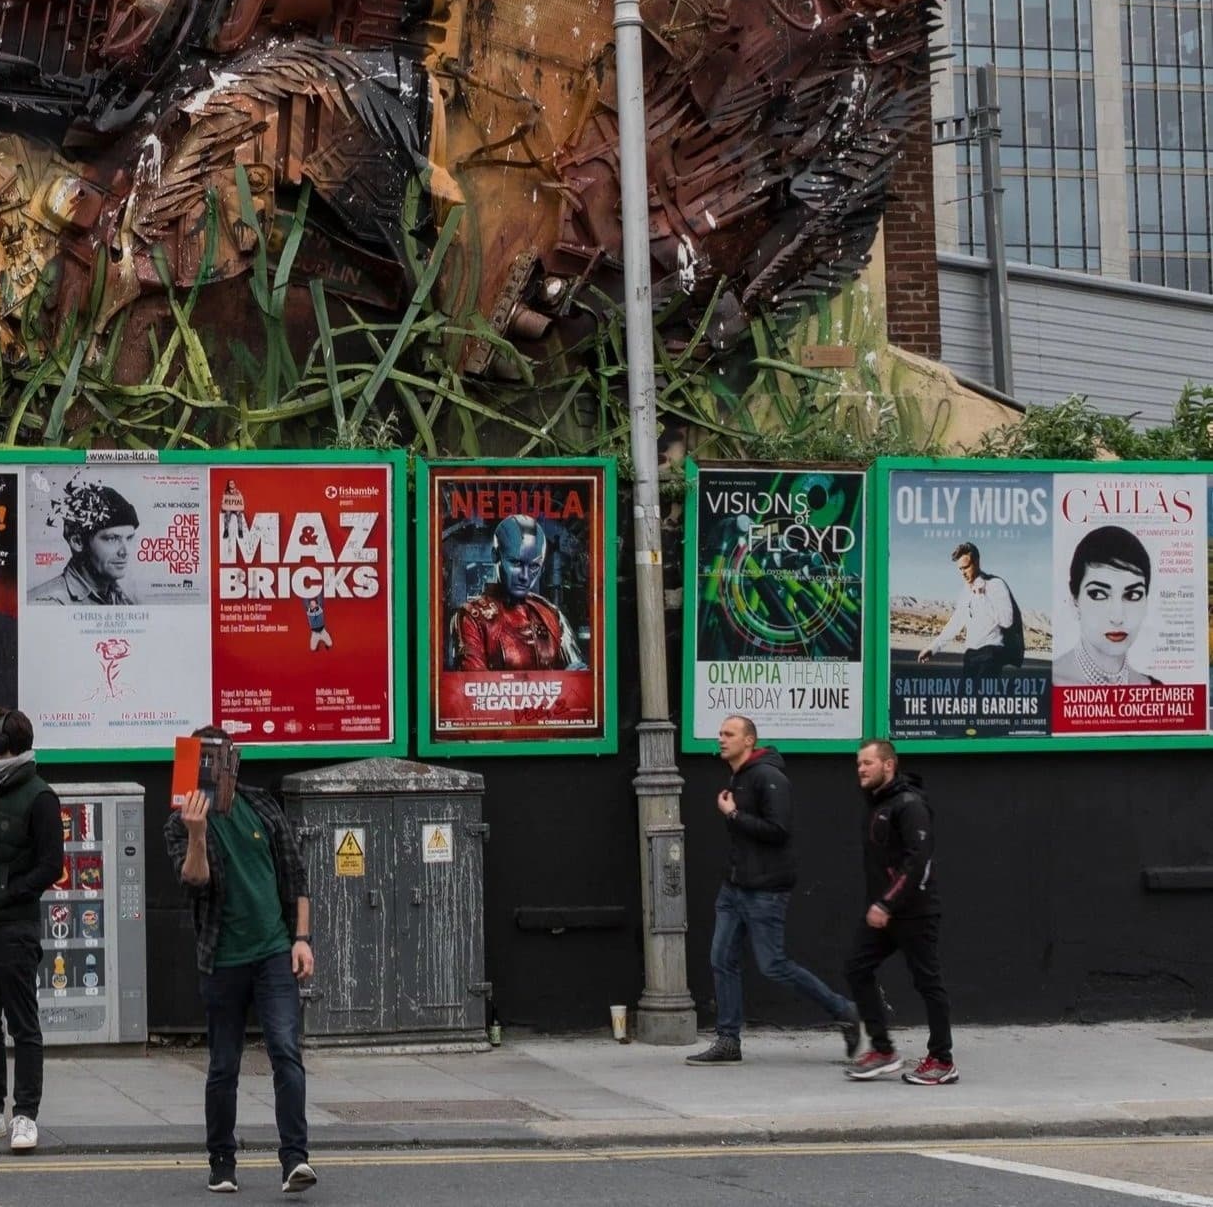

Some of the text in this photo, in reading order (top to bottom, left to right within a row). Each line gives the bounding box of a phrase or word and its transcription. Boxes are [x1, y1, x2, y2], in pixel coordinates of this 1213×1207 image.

[88, 451, 156, 461] www.ipa-ltd.ie
[338, 486, 380, 496] fishamble
[1096, 481, 1163, 489] CELEBRATING
[451, 489, 585, 520] NEBULA
[706, 491, 808, 515] VISIONS
[896, 486, 1048, 526] OLLY MURS
[1061, 488, 1194, 524] CALLAS
[173, 513, 200, 526] ONE
[794, 510, 811, 525] of
[167, 526, 200, 538] FLEW
[219, 512, 380, 564] MAZ
[298, 525, 319, 546] &
[748, 524, 855, 553] FLOYD
[140, 537, 200, 550] OVER THE
[137, 550, 200, 562] CUCKOO'S
[169, 562, 200, 574] NEST
[219, 565, 380, 600] BRICKS
[73, 612, 103, 621] CHRIS
[115, 612, 149, 621] BURGH
[708, 662, 850, 685] OLYMPIA THEATRE
[464, 680, 563, 697] GUARDIANS
[895, 678, 1047, 696] SATURDAY 8 JULY 2017
[707, 687, 850, 709] SATURDAY 17 JUNE
[1063, 687, 1195, 704] SUNDAY 17 SEPTEMBER
[472, 703, 487, 711] THE
[486, 696, 558, 711] GALAXY
[903, 697, 1038, 715] THE IVEAGH GARDENS
[1063, 703, 1194, 718] NATIONAL CONCERT HALL
[39, 713, 96, 721] 15 APRIL 2017
[121, 711, 177, 720] 16 APRIL 2017
